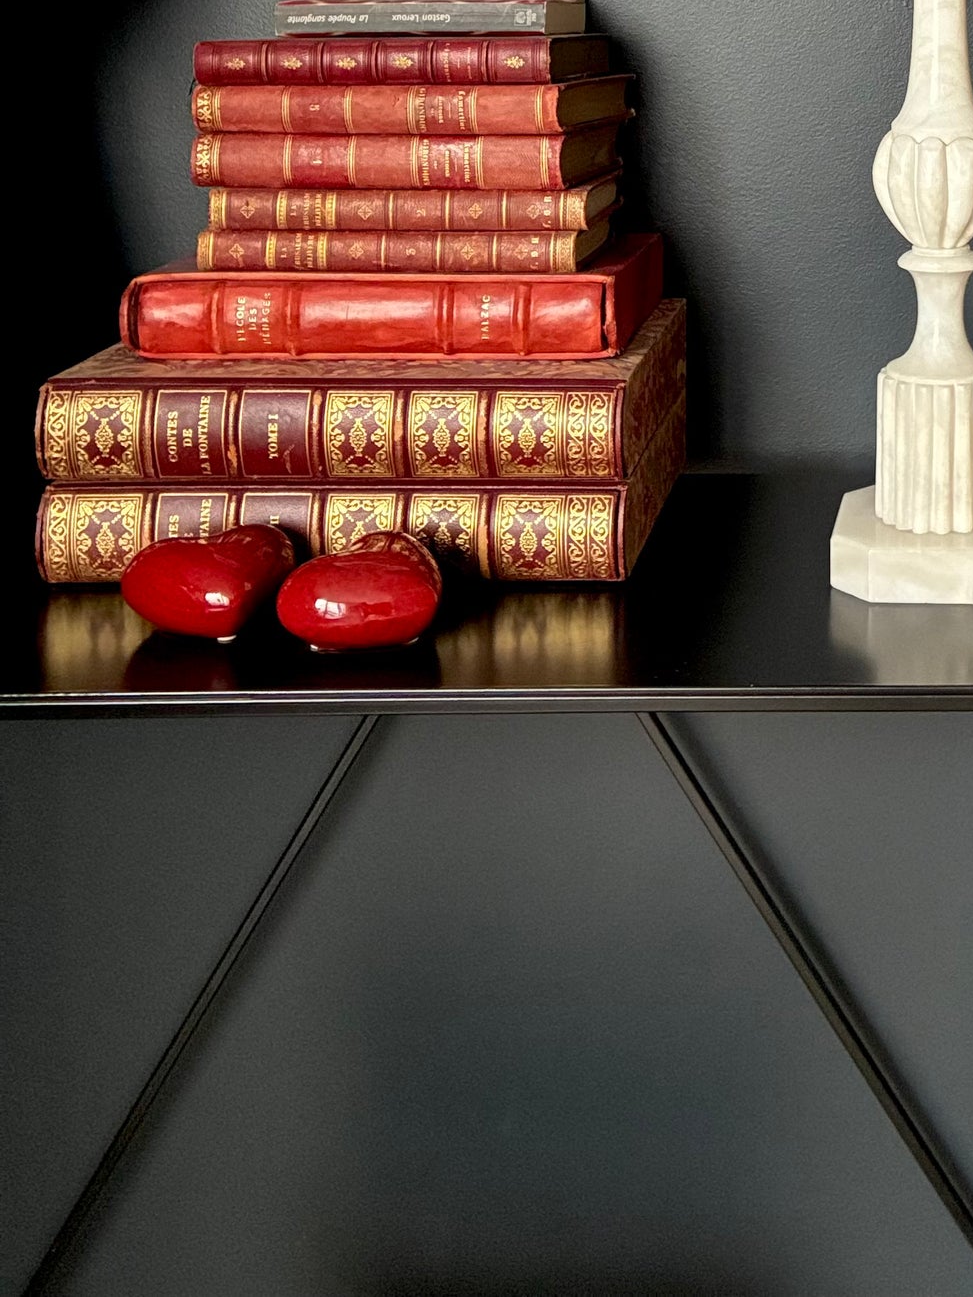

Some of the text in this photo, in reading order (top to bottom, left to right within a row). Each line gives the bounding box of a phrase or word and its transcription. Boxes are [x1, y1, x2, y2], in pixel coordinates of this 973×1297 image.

[287, 13, 369, 24] La Poupée sanglante
[392, 13, 451, 23] Gaston Leroux
[248, 308, 258, 331] DES
[480, 294, 491, 341] BALZAC
[166, 410, 179, 463] CONTES
[182, 428, 193, 448] DE
[197, 394, 213, 475] LA FONTAINE
[267, 413, 279, 459] TOME I
[168, 514, 180, 538] TES
[200, 498, 213, 539] TAINE
